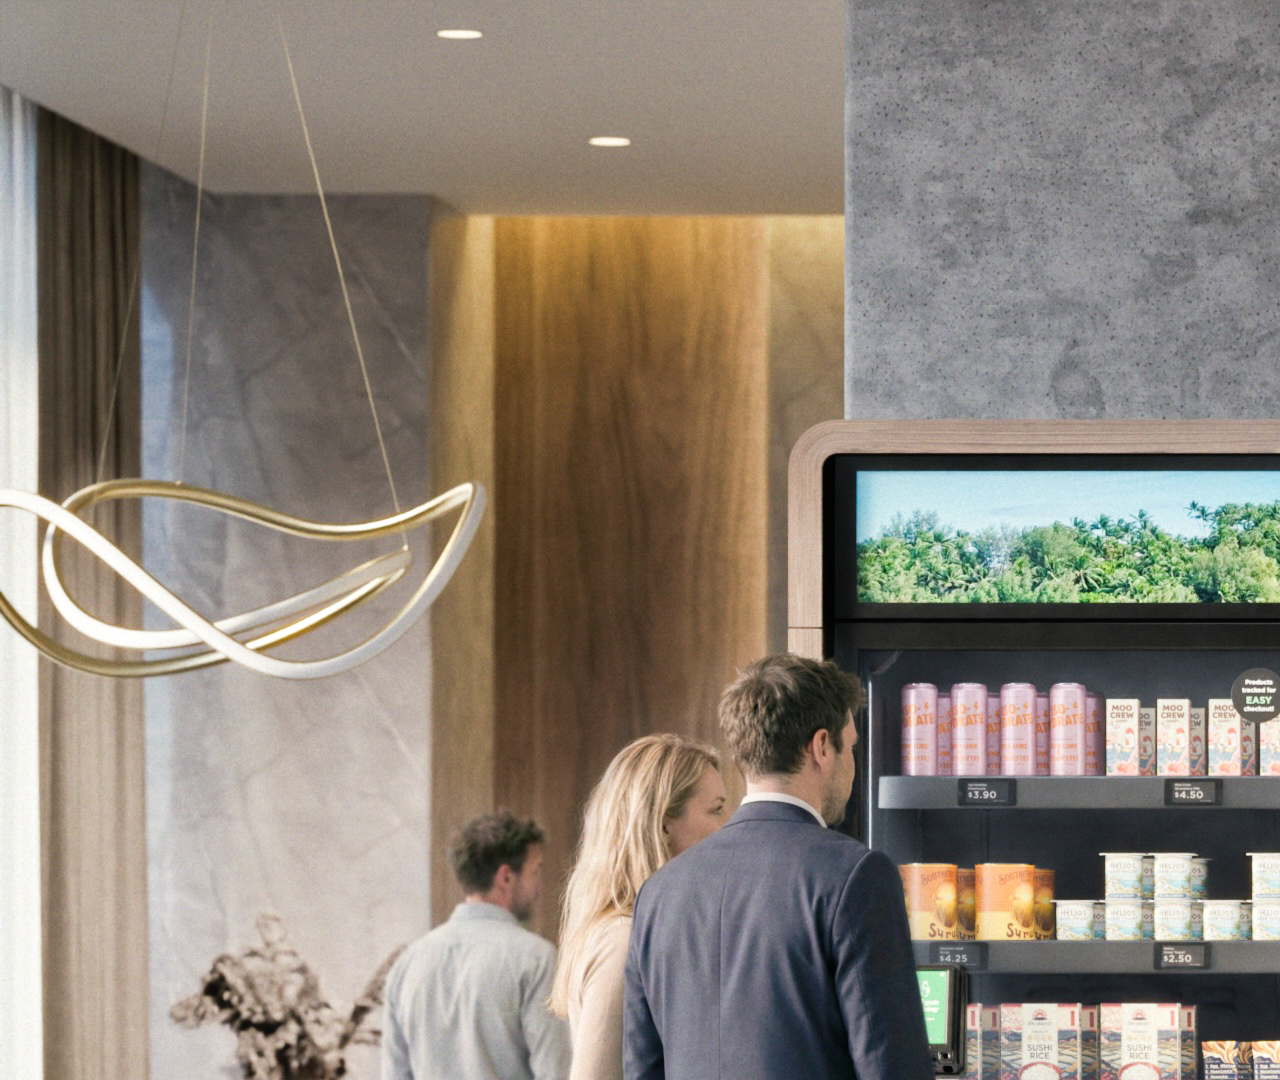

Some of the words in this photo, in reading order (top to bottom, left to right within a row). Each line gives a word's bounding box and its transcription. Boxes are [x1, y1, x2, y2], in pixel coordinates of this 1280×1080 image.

[1246, 696, 1272, 704] EASY
[968, 791, 997, 799] $3.90
[1174, 791, 1204, 799] $4.50
[939, 955, 968, 963] $4.25
[1163, 955, 1192, 963] $2.50
